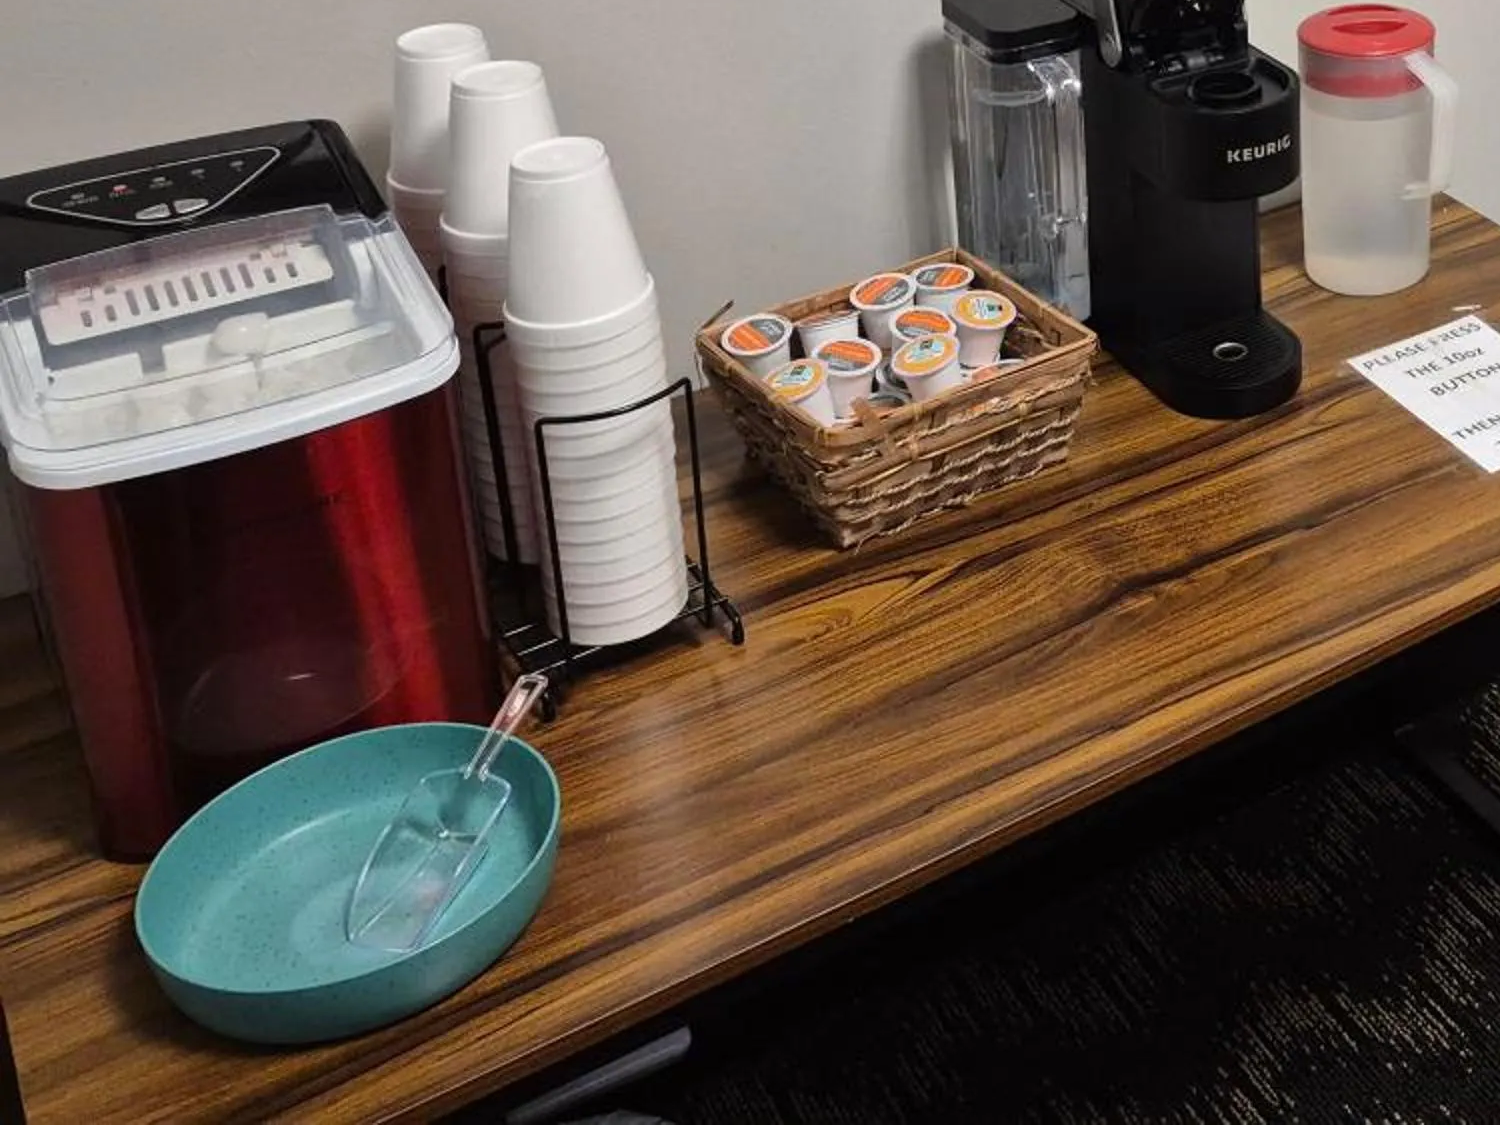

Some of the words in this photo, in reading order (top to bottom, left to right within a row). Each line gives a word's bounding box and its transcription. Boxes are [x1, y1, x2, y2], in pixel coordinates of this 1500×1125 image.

[1226, 134, 1291, 164] KEURIG
[1362, 342, 1425, 371] PLEASE
[1427, 322, 1482, 346] PRESS
[1406, 361, 1442, 379] THE
[1443, 347, 1486, 365] 10oz
